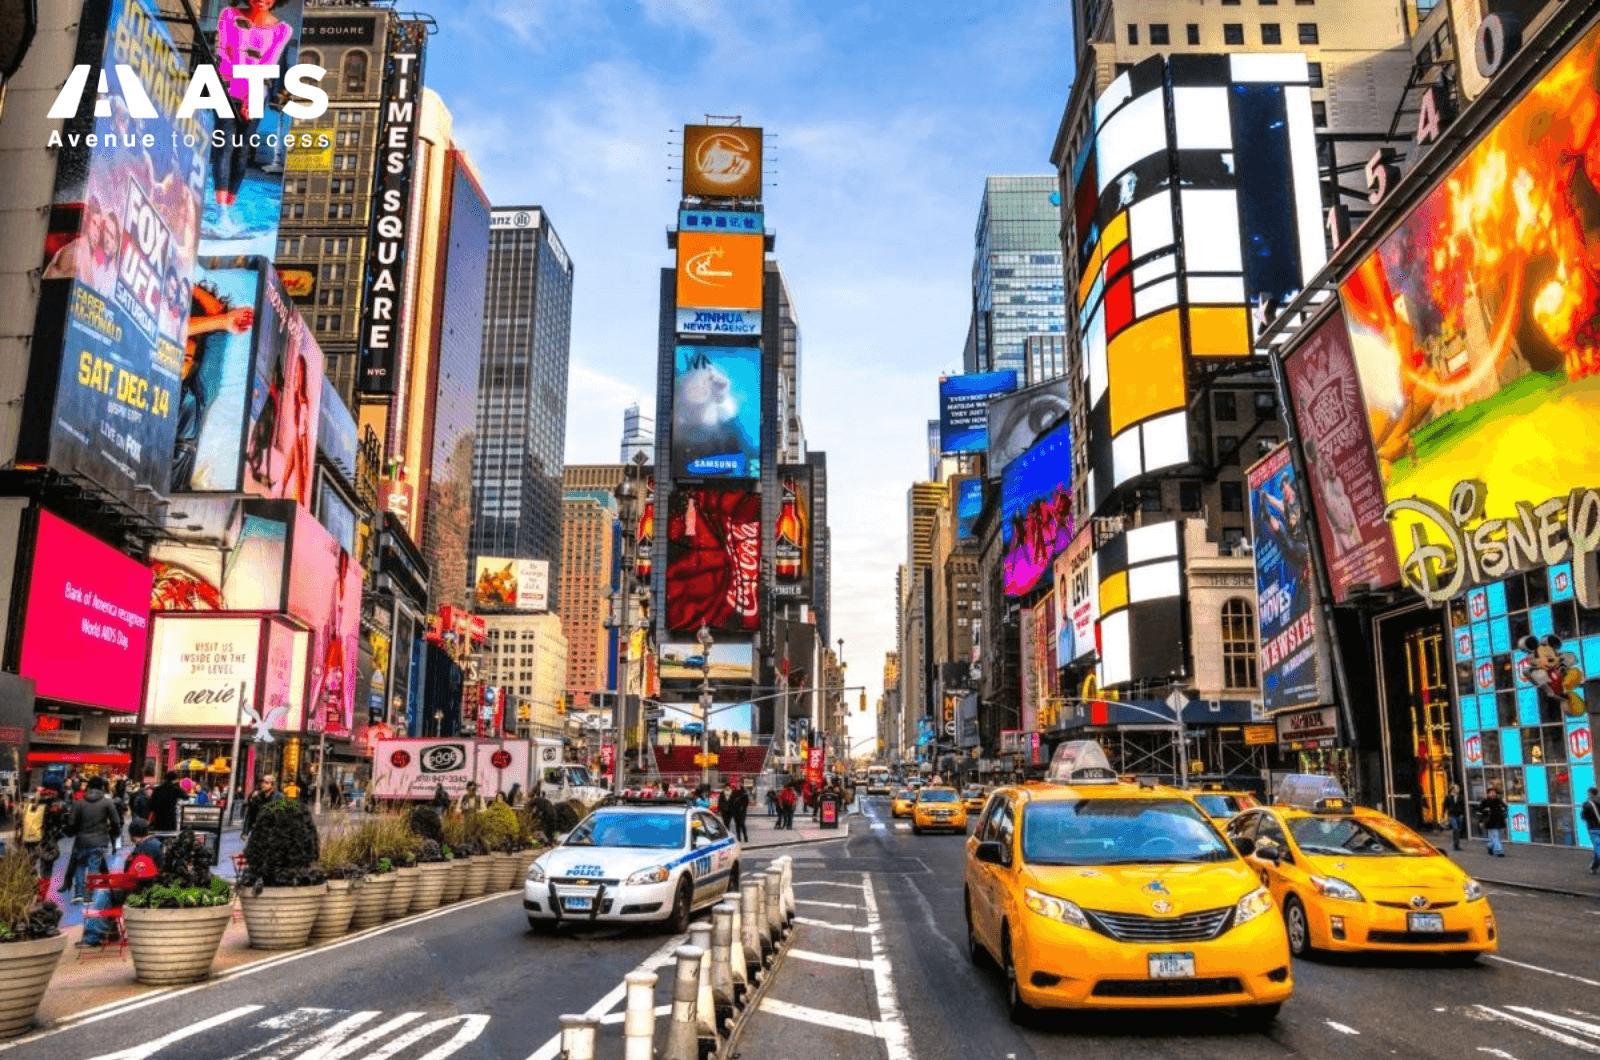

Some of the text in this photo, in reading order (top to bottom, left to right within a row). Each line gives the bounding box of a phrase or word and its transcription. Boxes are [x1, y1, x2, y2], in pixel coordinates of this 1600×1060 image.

[387, 53, 417, 174] TIMES
[130, 184, 170, 279] FOX
[369, 190, 403, 349] SQUARE
[121, 245, 163, 317] UFC
[116, 283, 158, 340] SATURDAY
[695, 312, 744, 323] XINHUA
[683, 323, 756, 332] NEWS AGENCY
[367, 368, 386, 377] NYC
[152, 386, 170, 419] 14
[694, 459, 738, 469] SAMSUNG
[65, 581, 83, 603] Bank
[84, 591, 92, 606] of
[92, 593, 118, 617] America
[82, 617, 129, 651] World AIDS Day
[181, 653, 247, 663] INSIDE ON THE
[195, 642, 234, 652] VISIT US
[207, 664, 234, 675] LEVEL
[183, 683, 235, 705] aerie
[565, 869, 605, 878] POLICE
